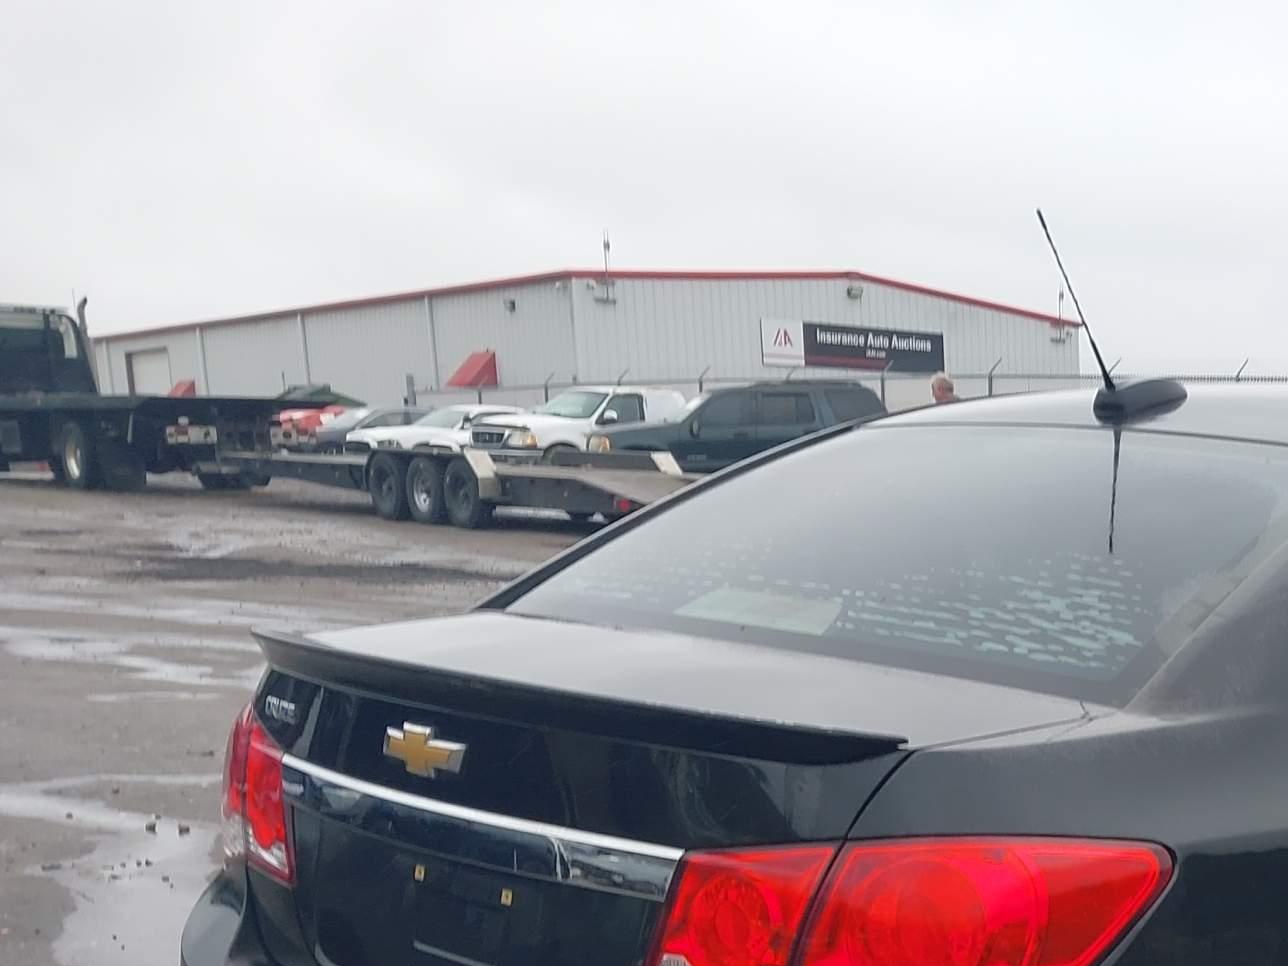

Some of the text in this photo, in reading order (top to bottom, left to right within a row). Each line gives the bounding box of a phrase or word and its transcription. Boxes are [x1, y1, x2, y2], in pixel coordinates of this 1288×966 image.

[816, 327, 932, 353] Insurance Auto Auctions
